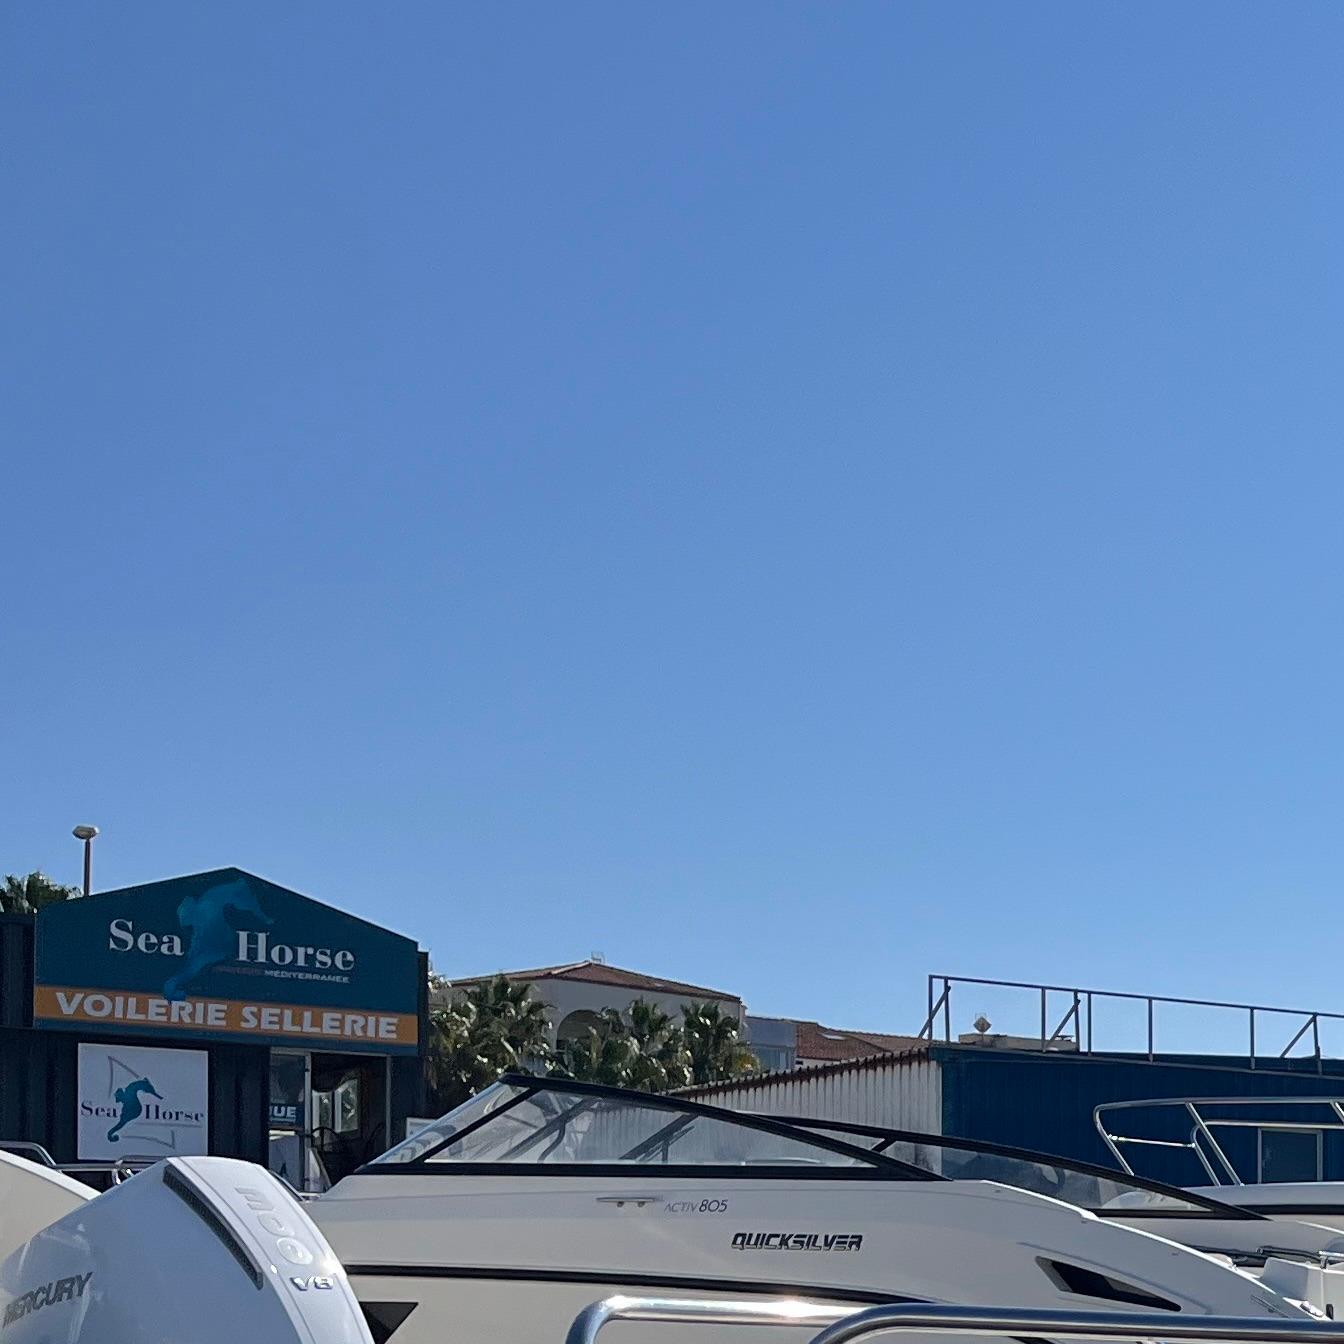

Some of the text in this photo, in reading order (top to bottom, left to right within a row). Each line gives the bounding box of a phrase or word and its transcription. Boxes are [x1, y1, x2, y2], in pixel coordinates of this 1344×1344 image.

[109, 918, 355, 972] Sea Horse
[56, 992, 399, 1039] VOILERIE SELLERIE
[81, 1101, 204, 1122] Sea Horse
[699, 1199, 728, 1213] 805
[731, 1232, 863, 1251] QUICKSILVER
